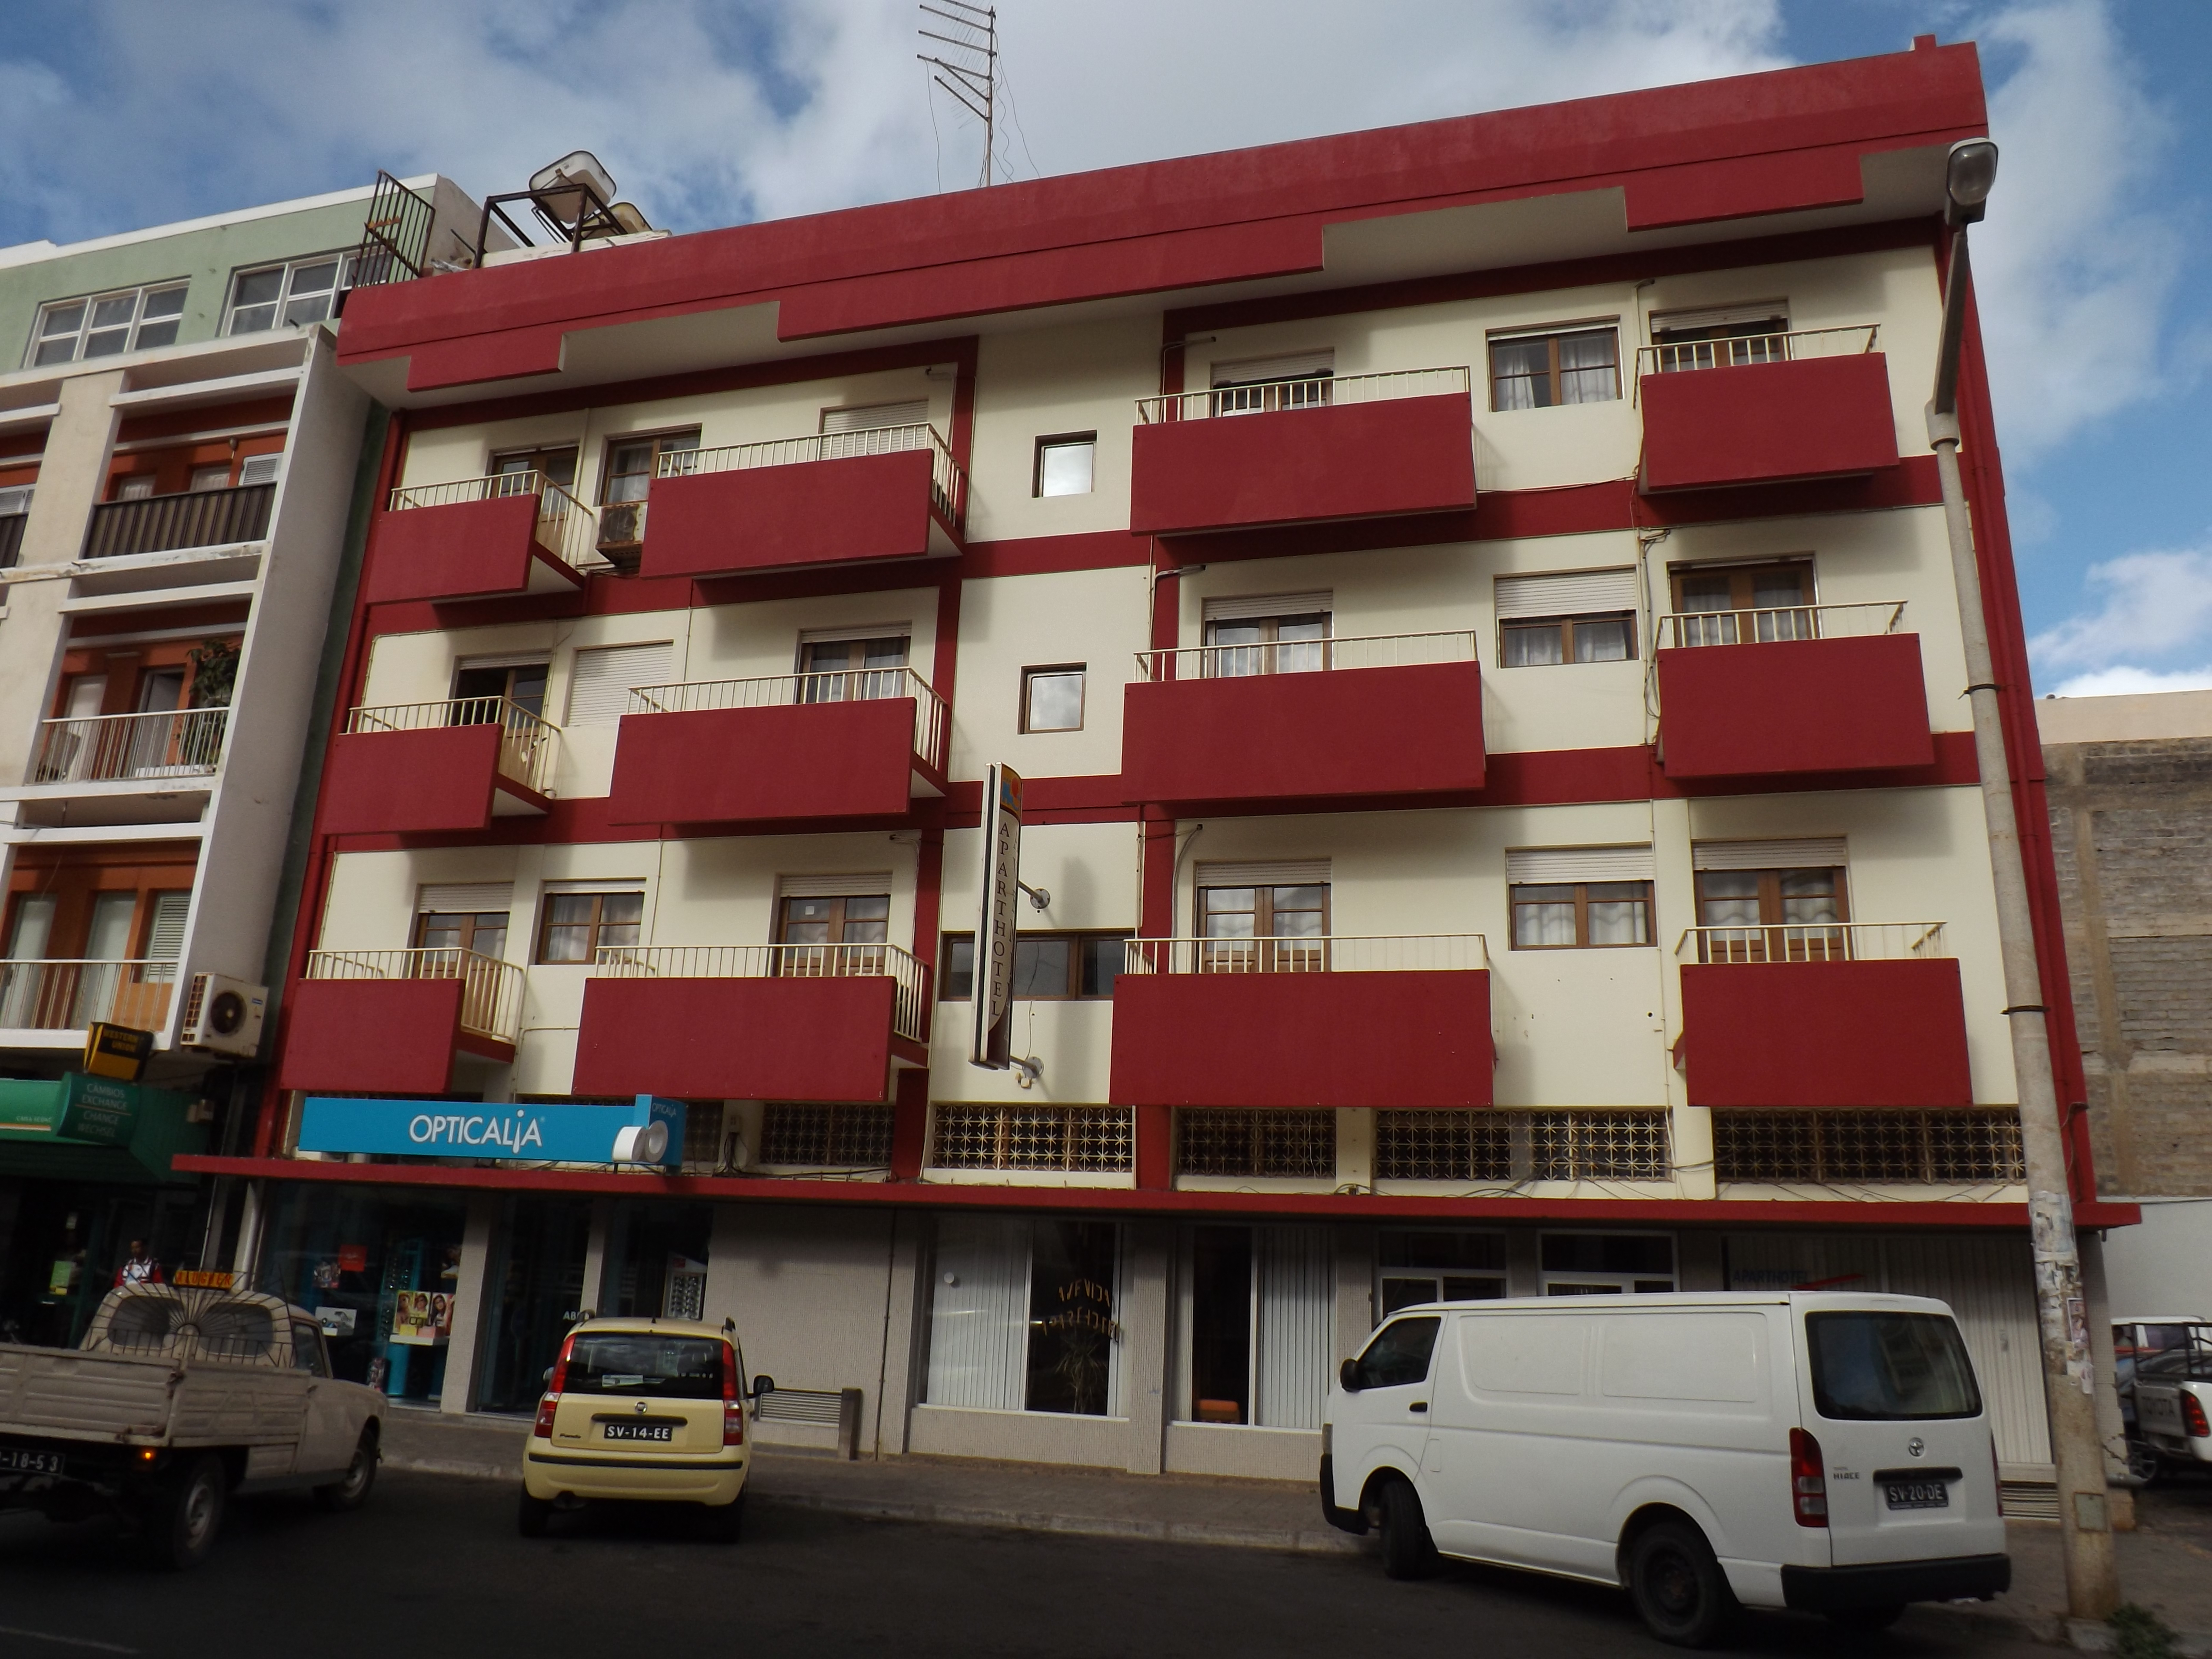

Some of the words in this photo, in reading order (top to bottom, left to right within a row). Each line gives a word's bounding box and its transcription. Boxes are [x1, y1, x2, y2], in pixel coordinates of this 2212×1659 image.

[991, 821, 1011, 1016] APARTHOTEL
[82, 1094, 128, 1109] EXCHANGE
[84, 1110, 120, 1125] CHANGE
[1732, 1269, 1810, 1284] APARTHOTEL
[607, 1425, 670, 1439] SV-14-EE
[0, 1450, 59, 1473] -18-53
[1833, 1472, 1860, 1480] HIACE
[1889, 1483, 1944, 1502] SV-20-DE
